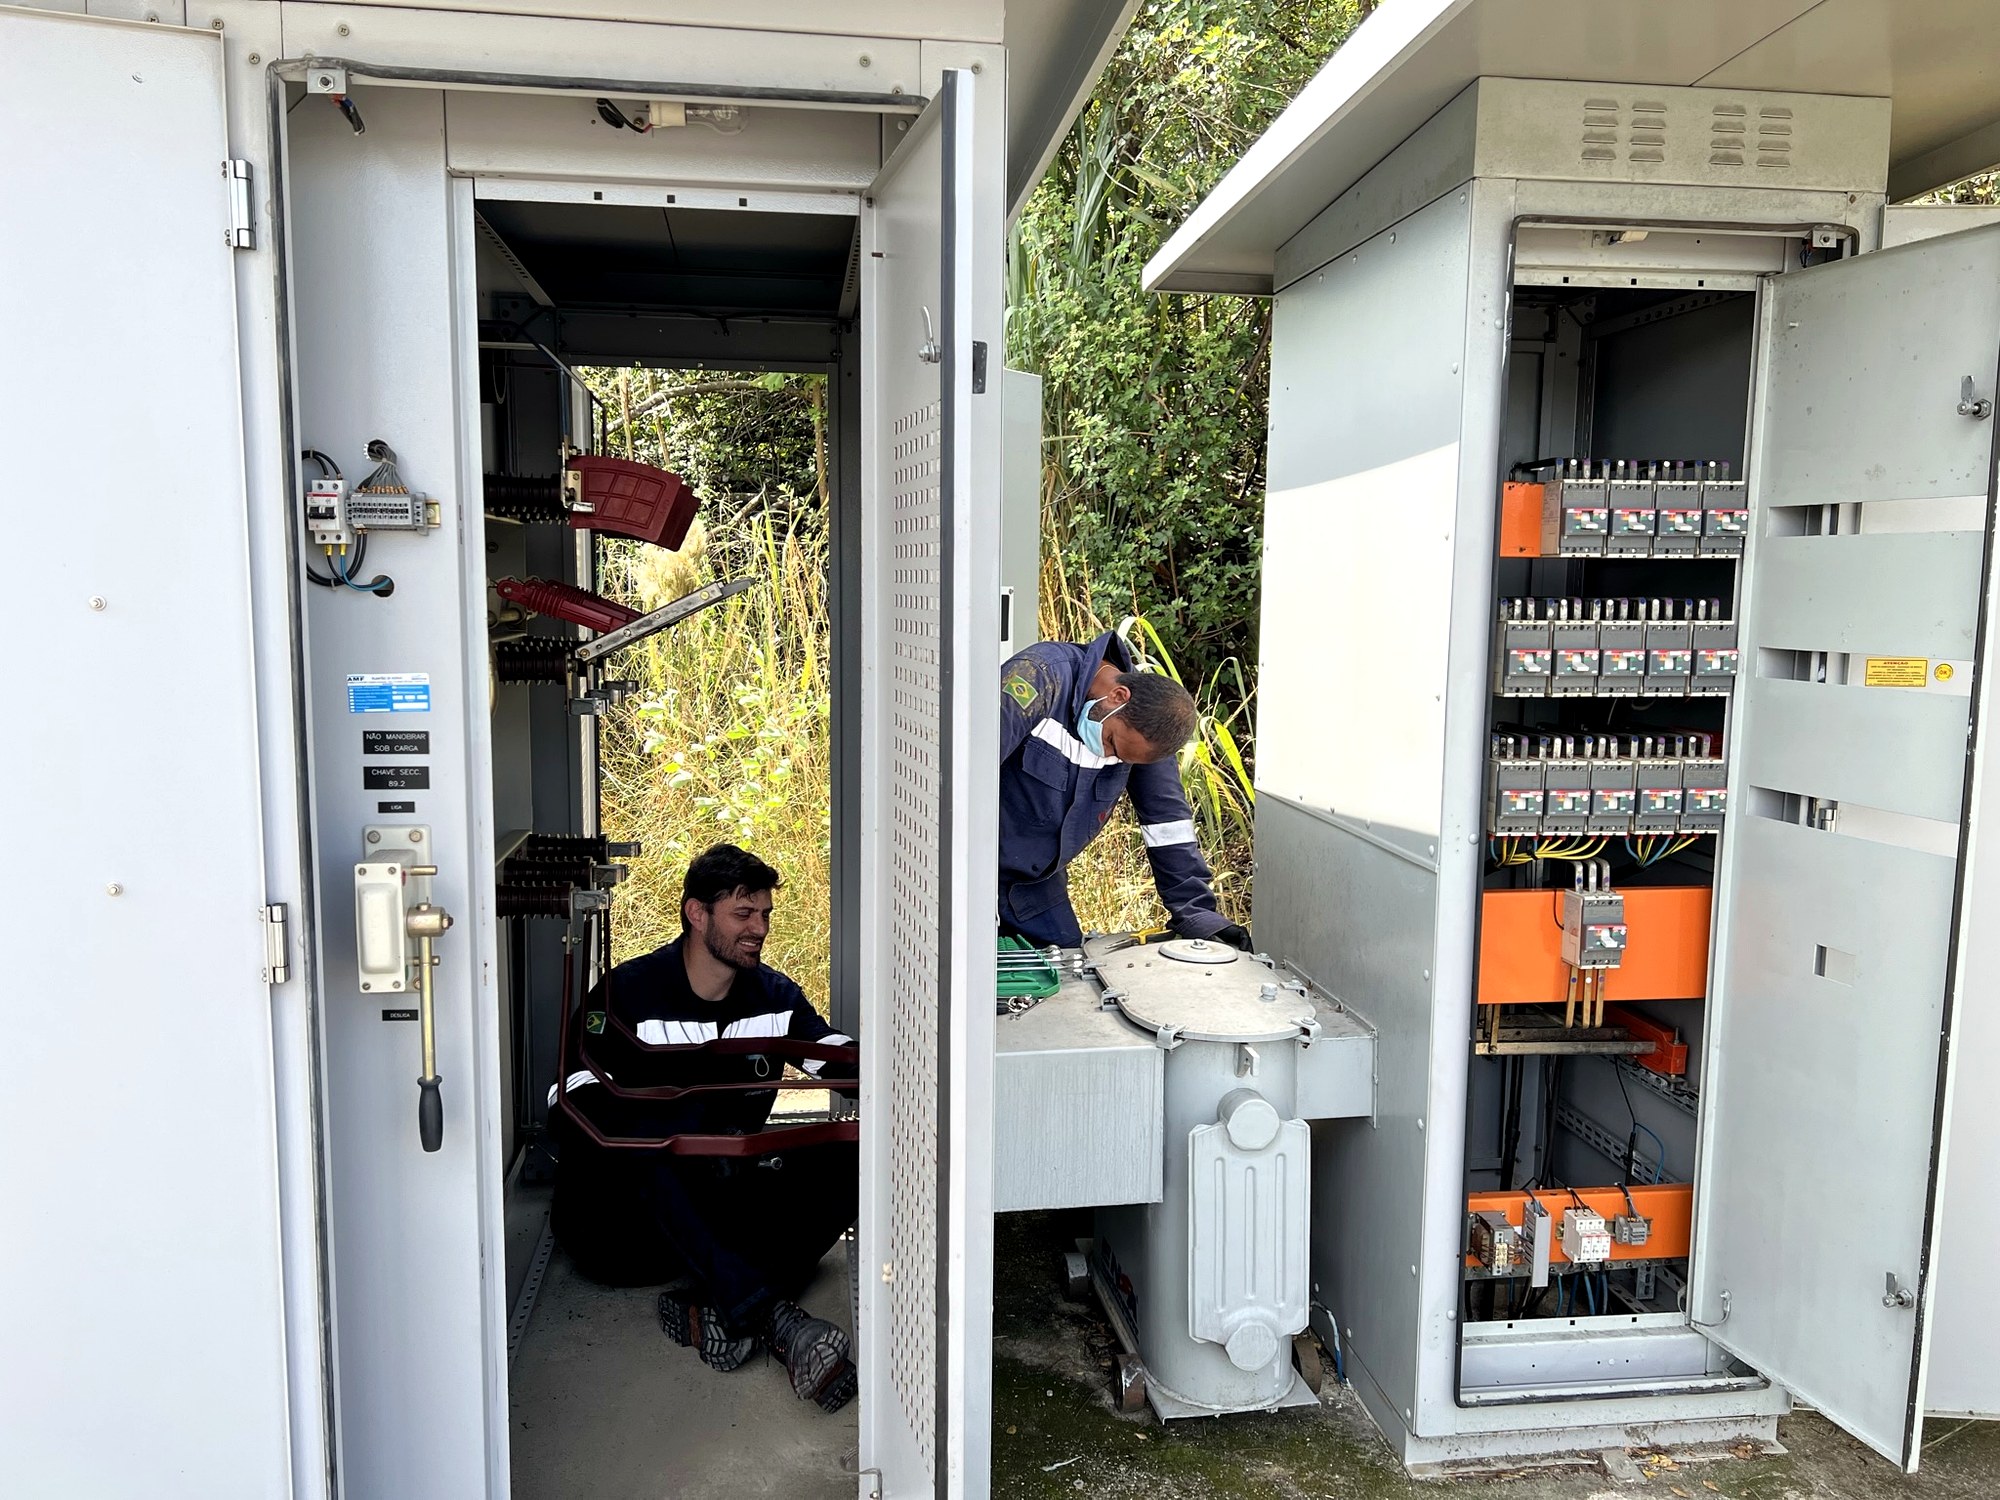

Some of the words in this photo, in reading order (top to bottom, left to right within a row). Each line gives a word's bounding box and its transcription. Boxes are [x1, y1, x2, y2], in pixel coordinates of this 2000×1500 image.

[366, 732, 382, 740] NÃO
[374, 744, 390, 752] SOB
[394, 744, 419, 752] CARGA
[371, 768, 396, 776] CHAVE
[399, 768, 422, 776] SECC.
